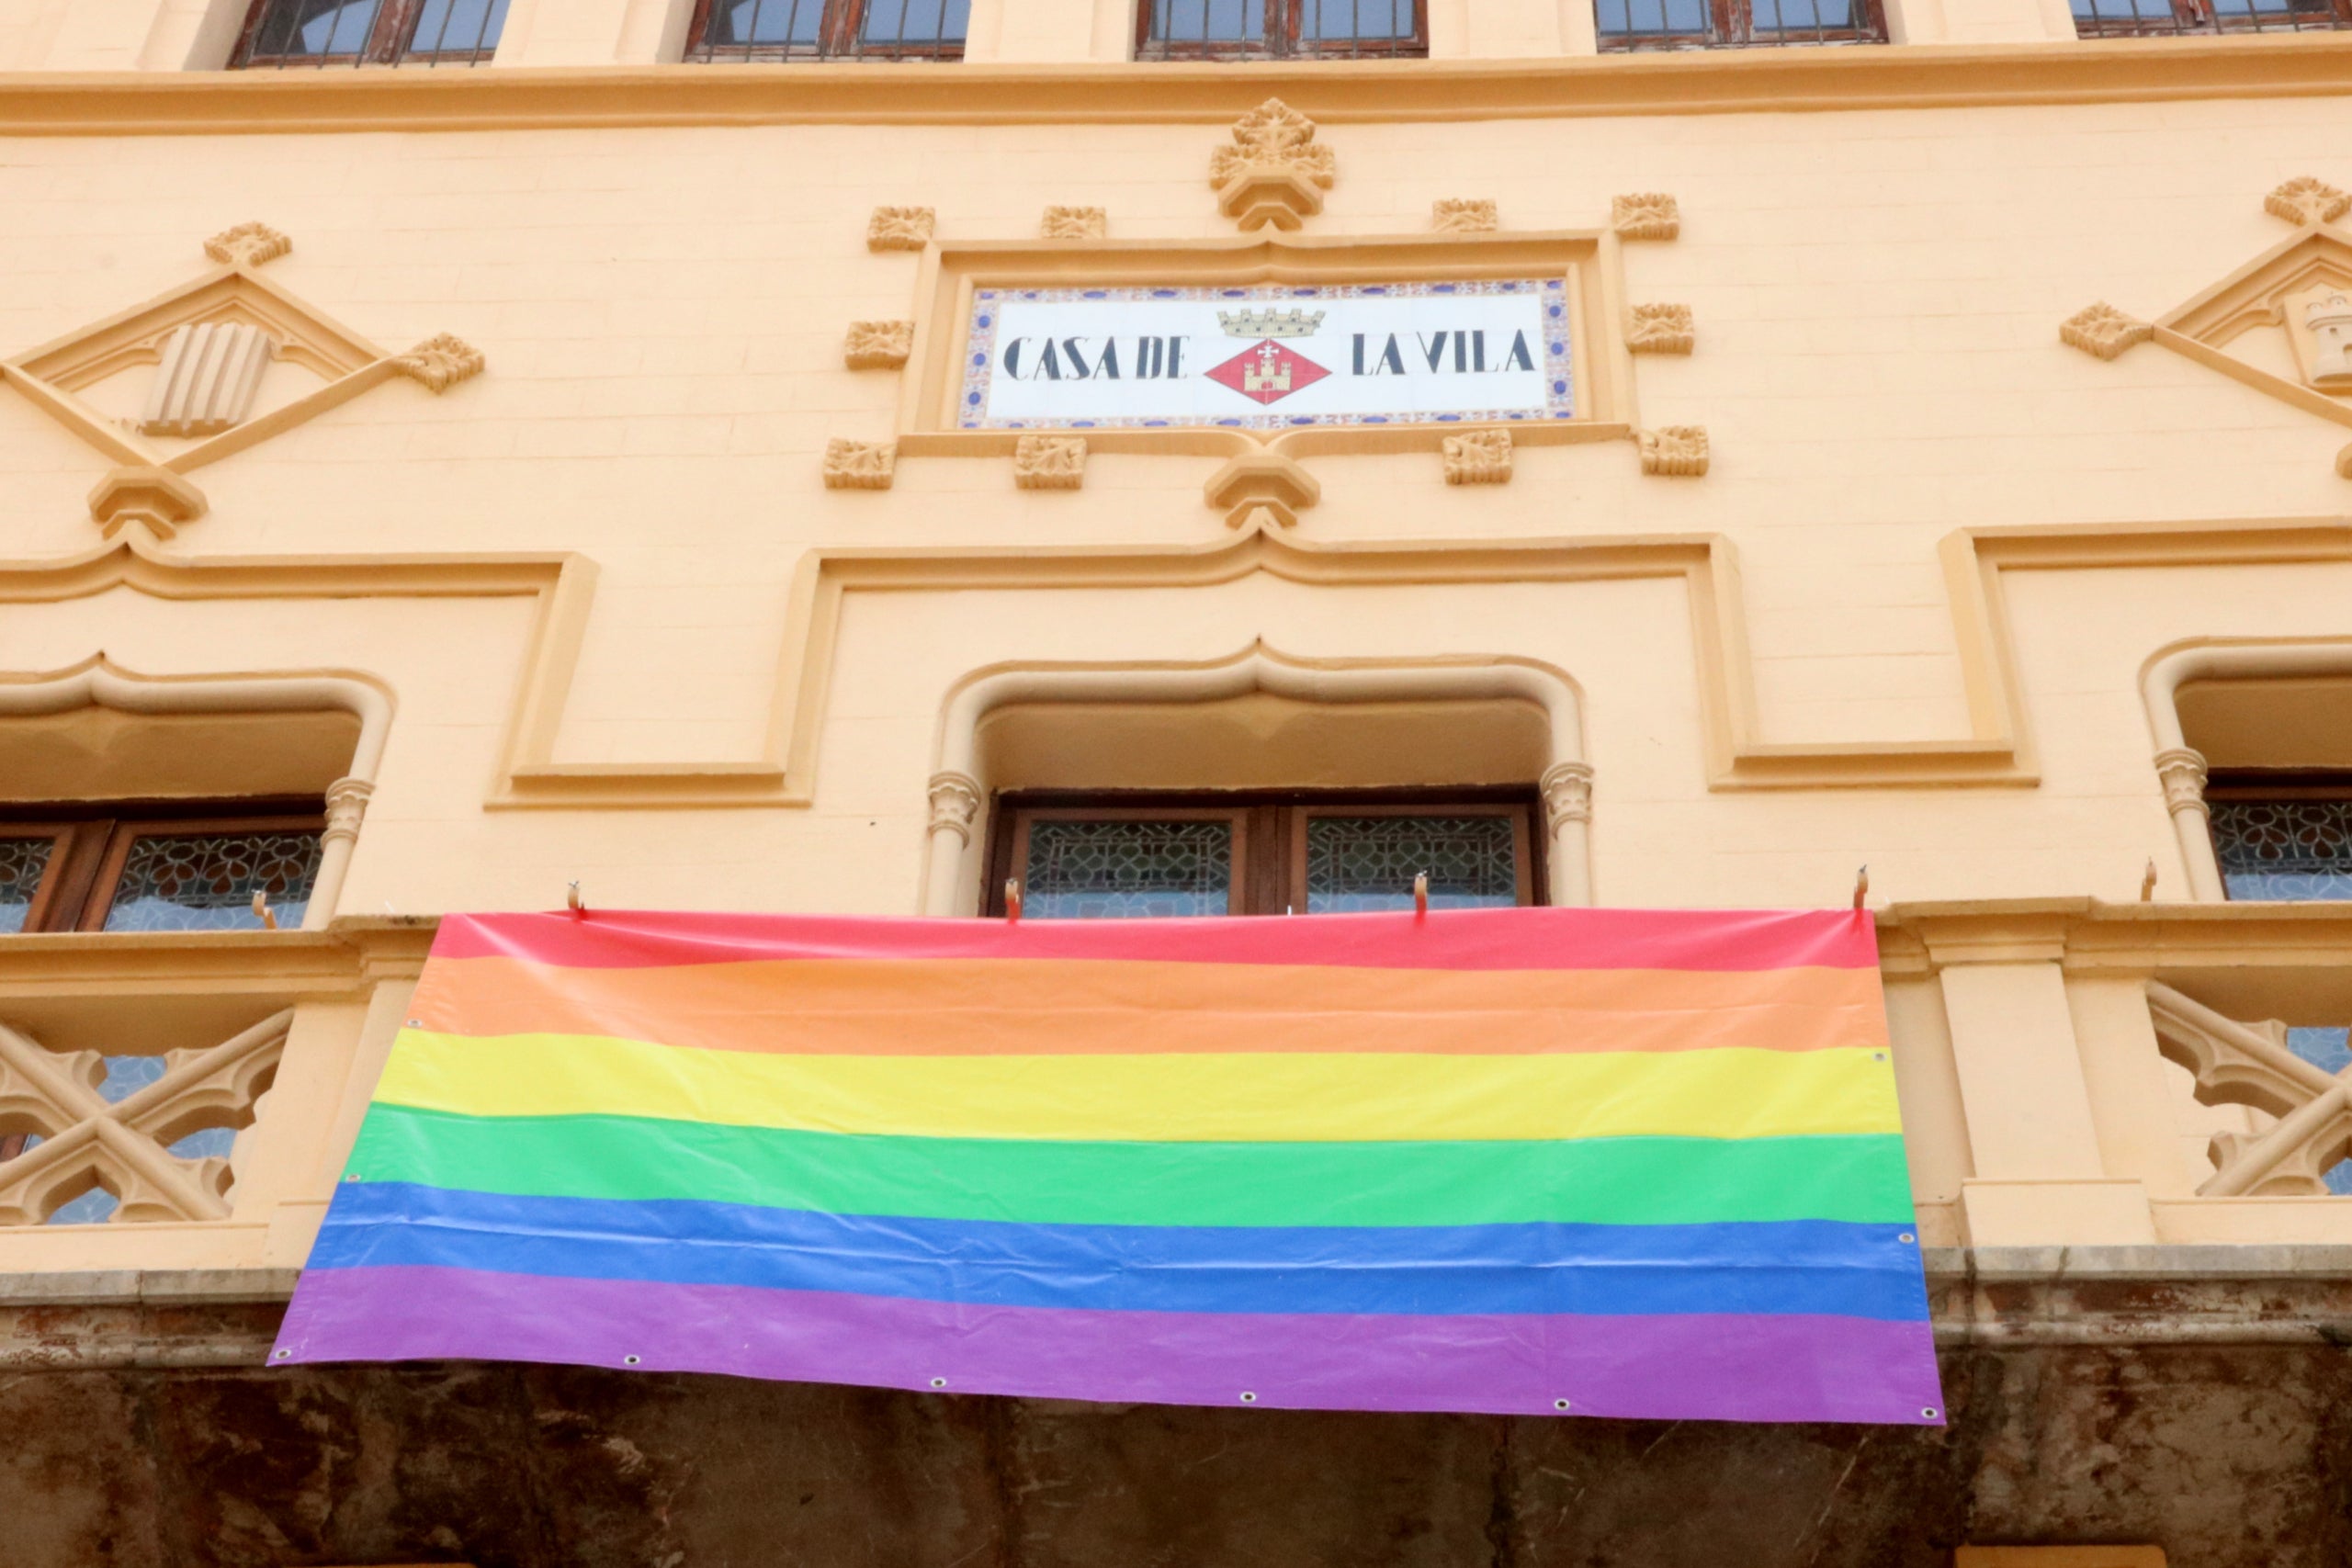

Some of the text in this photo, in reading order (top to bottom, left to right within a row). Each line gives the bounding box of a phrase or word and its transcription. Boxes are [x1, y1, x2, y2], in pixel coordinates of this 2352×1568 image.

[1003, 329, 1535, 380] CASA DE LA VILA
